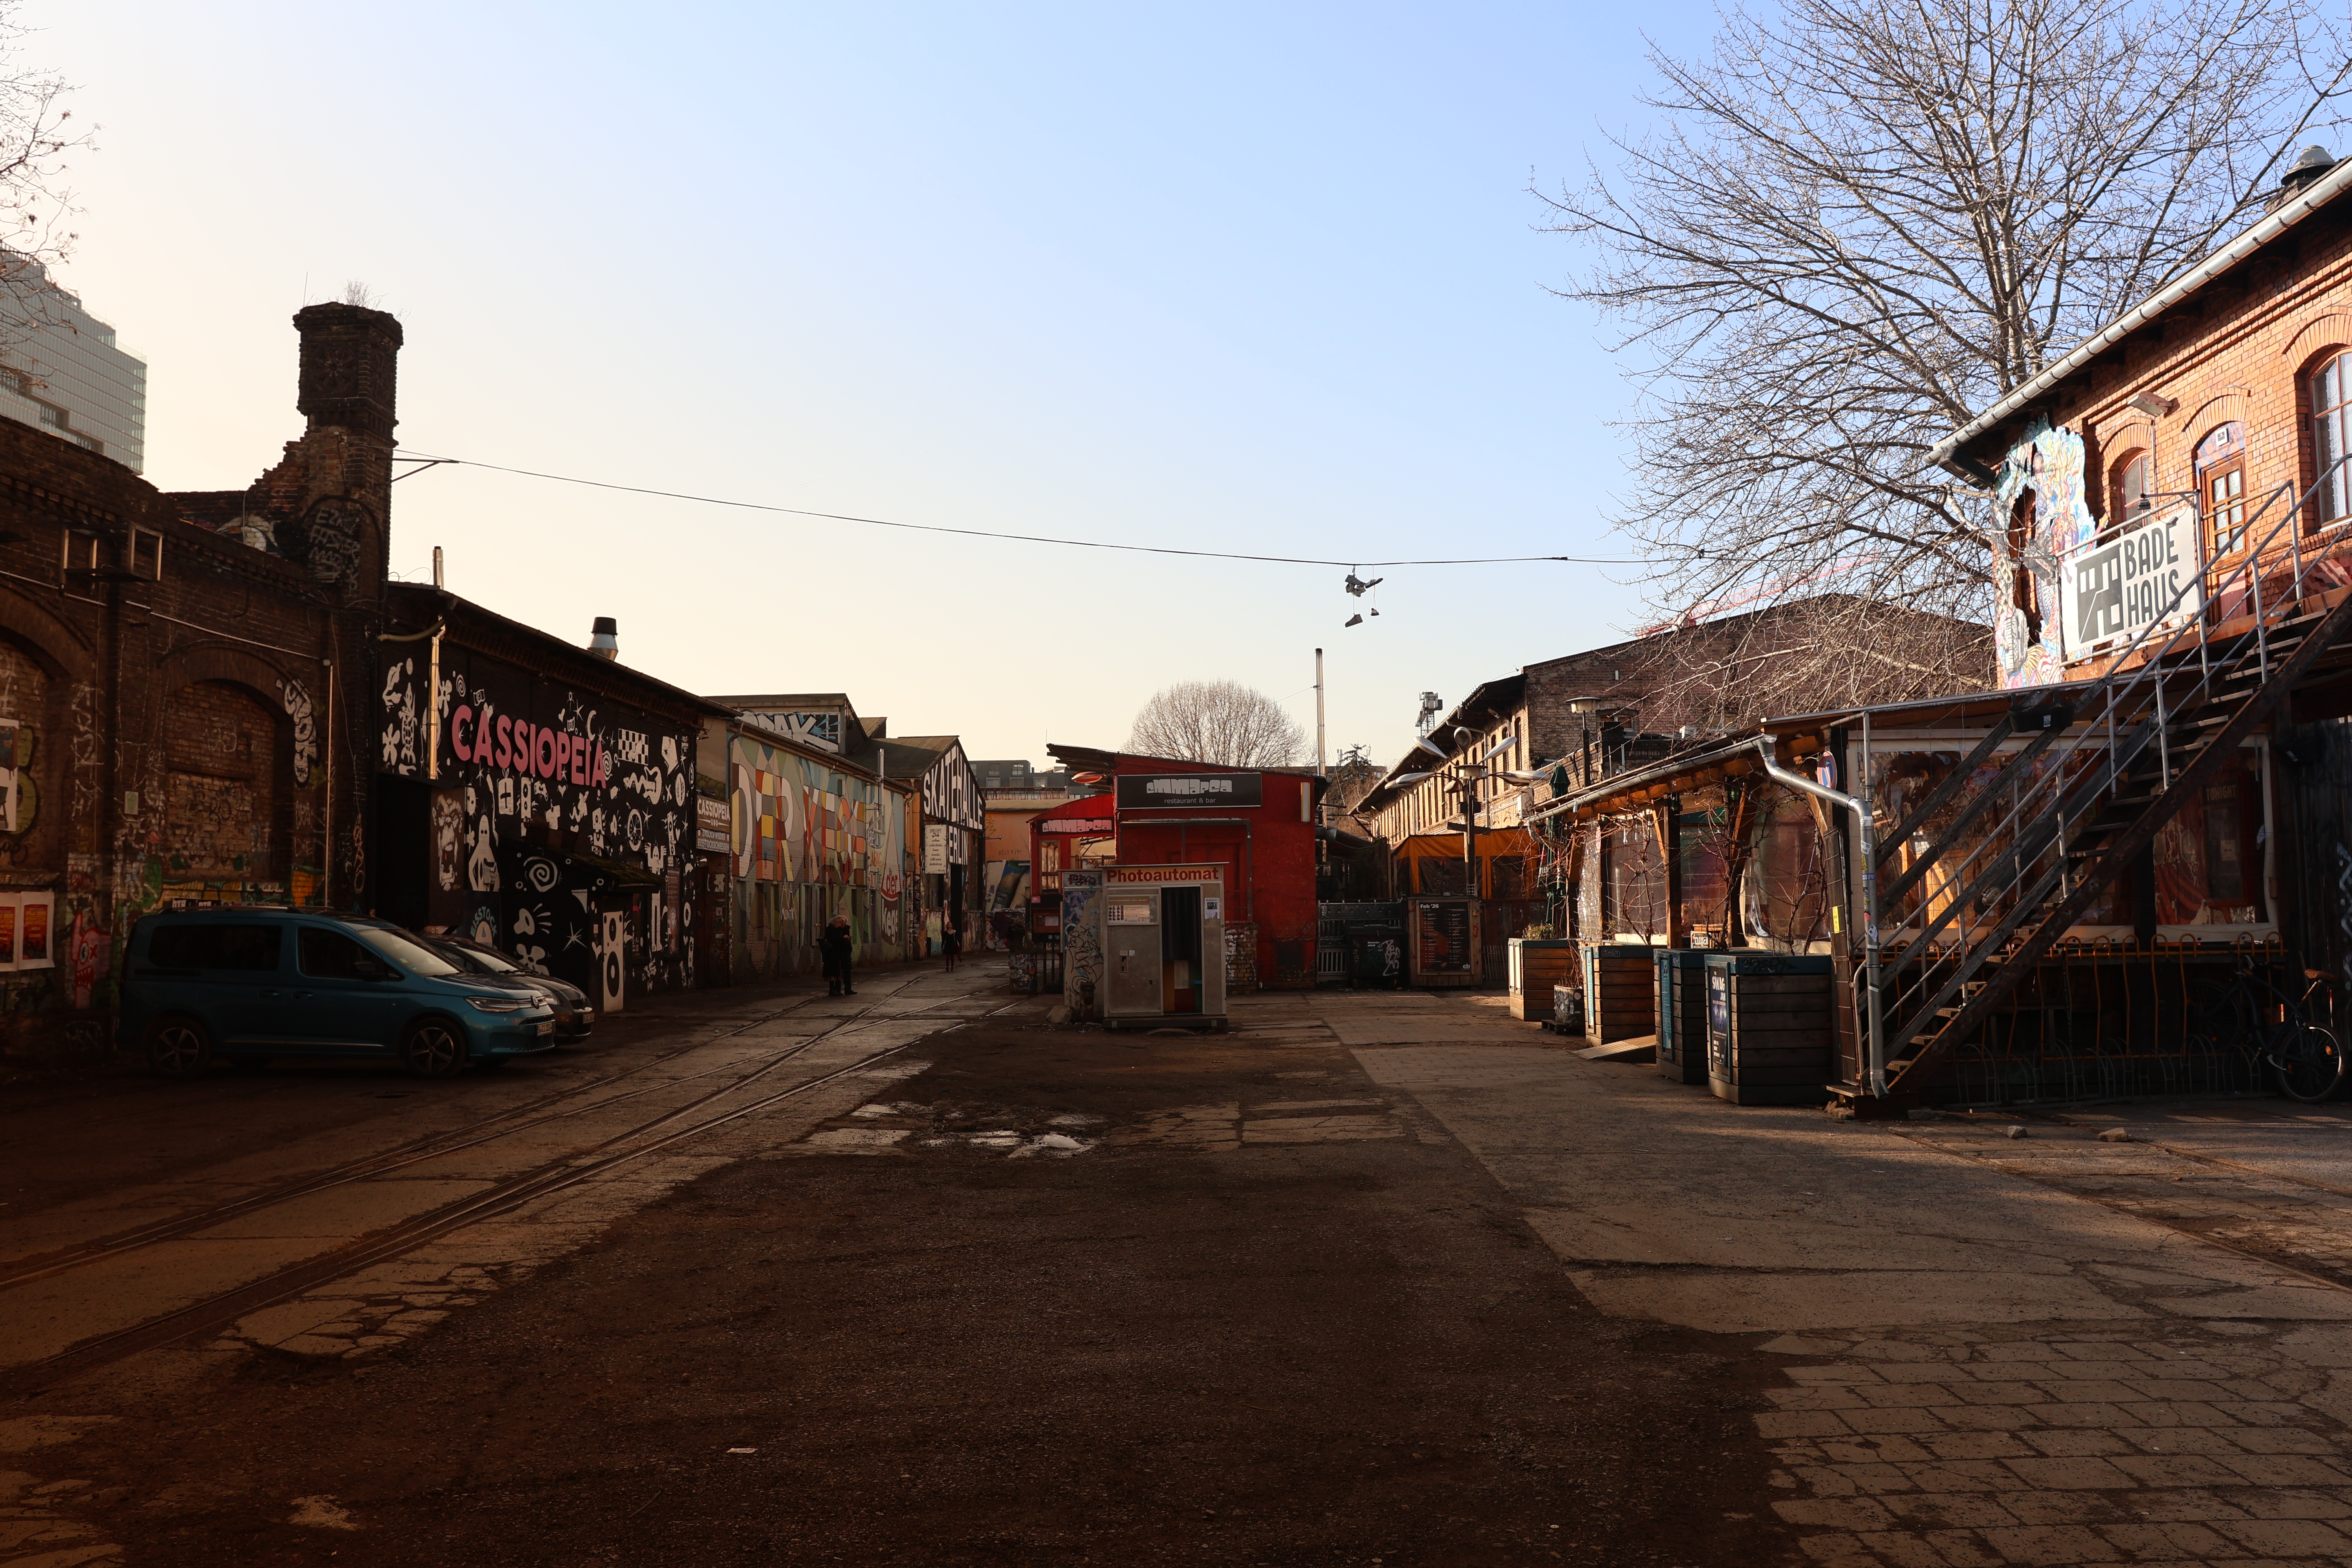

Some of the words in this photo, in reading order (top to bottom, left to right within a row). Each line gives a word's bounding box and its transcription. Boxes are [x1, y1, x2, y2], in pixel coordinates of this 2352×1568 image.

[2123, 522, 2179, 581] BADE
[2127, 569, 2181, 628] HAUS
[452, 704, 607, 789] CASSIOPEIA
[924, 745, 983, 829] SKATEHALLE
[2206, 785, 2236, 801] TONIGHT
[697, 799, 730, 821] CASSIOPEIA
[697, 838, 730, 851] EISSTOCKSCHIESSEN
[702, 829, 715, 839] ENDLICH
[715, 832, 725, 841] WIEDER
[947, 825, 968, 866] ERLIN
[887, 867, 898, 895] der
[1107, 867, 1219, 882] Photoautomat
[470, 906, 497, 937] EISSTOCK
[1695, 936, 1709, 945] CLOSED
[1712, 976, 1725, 991] SWAG
